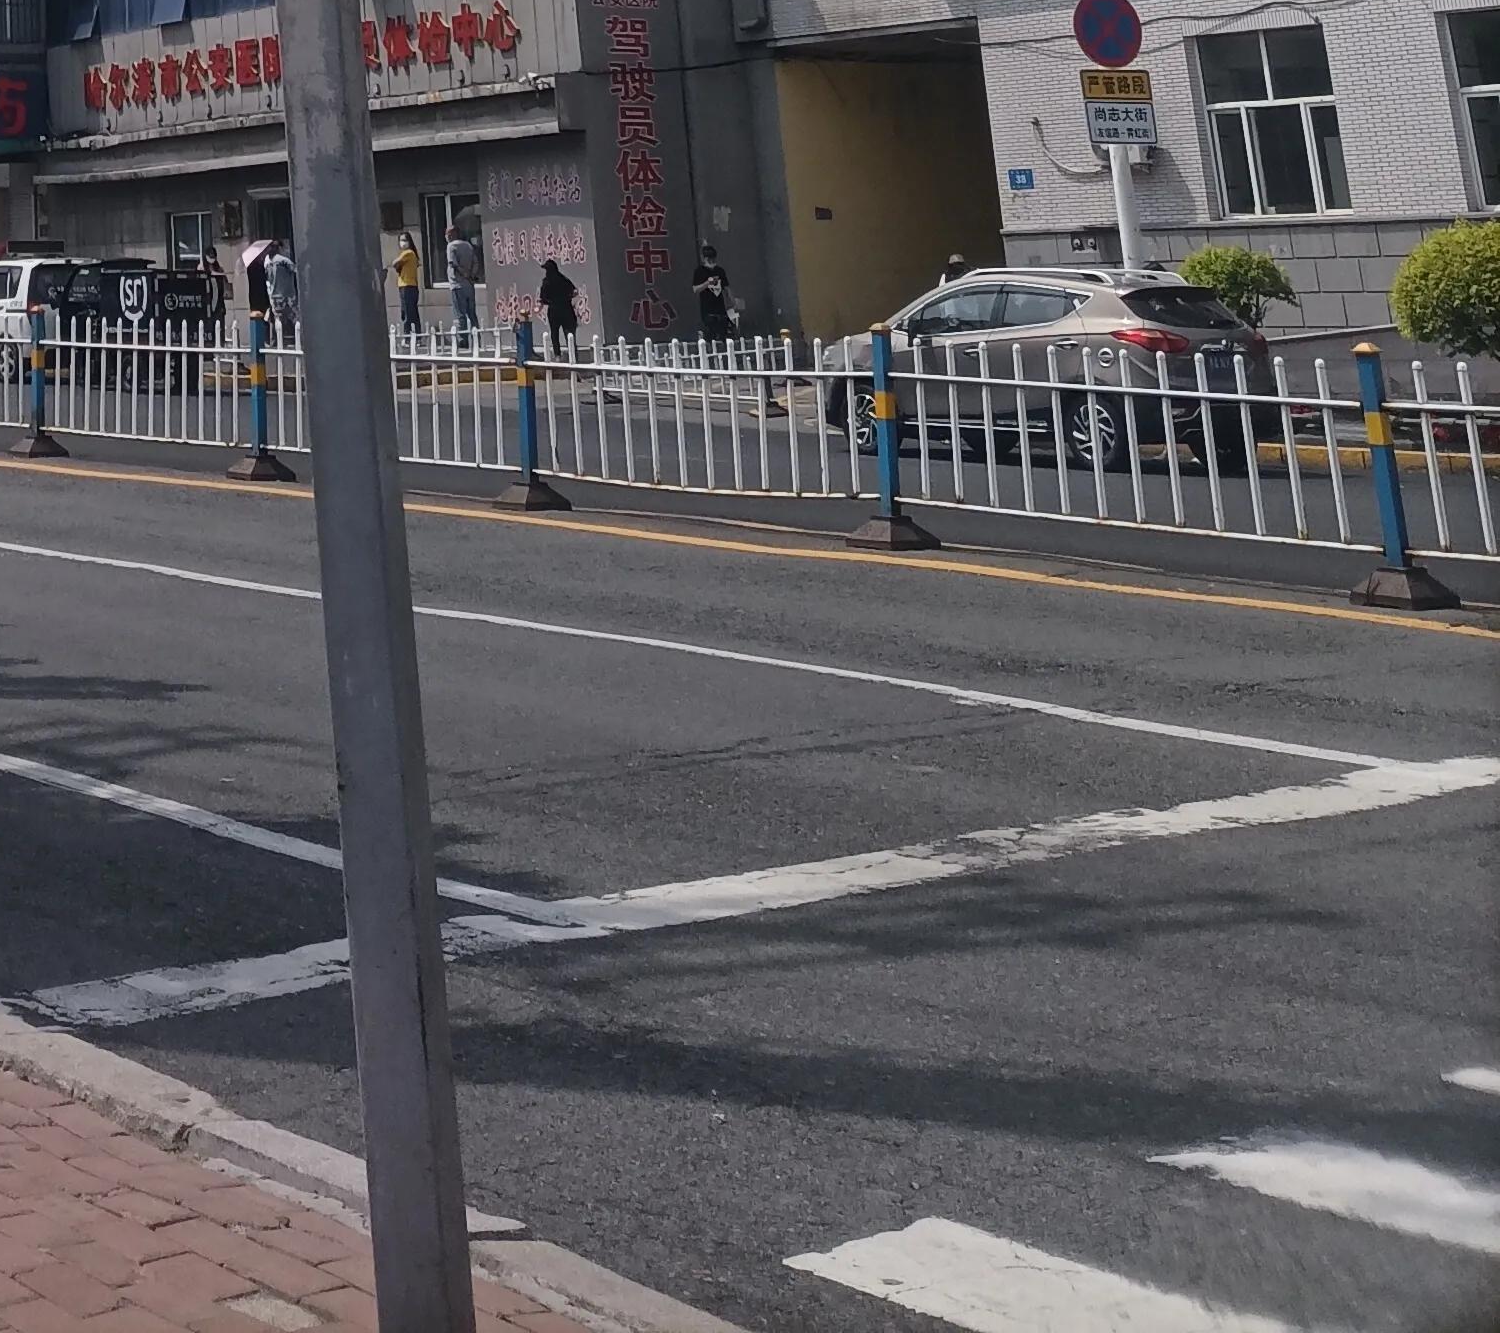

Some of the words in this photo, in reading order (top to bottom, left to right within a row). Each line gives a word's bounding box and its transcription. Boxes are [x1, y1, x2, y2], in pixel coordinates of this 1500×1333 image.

[1086, 75, 1146, 95] 严管路段
[1094, 107, 1148, 123] 尚志大街
[606, 16, 678, 330] 驾驶员体检中心
